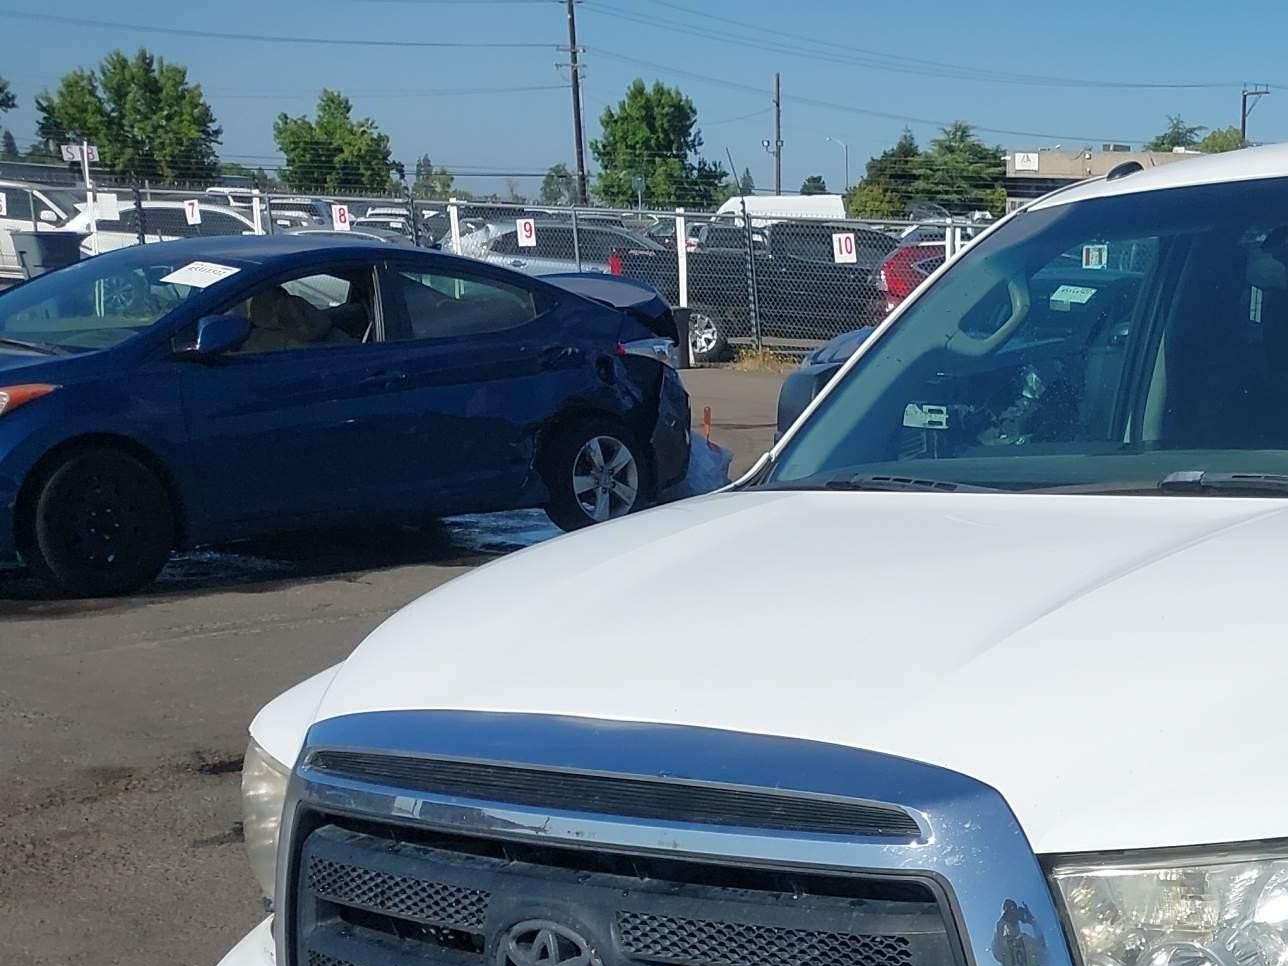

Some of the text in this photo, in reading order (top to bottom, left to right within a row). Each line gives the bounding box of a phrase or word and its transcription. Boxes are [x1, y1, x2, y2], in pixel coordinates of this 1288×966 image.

[187, 202, 196, 218] 7
[337, 207, 347, 224] 8
[522, 221, 533, 239] 9
[838, 235, 853, 255] 10
